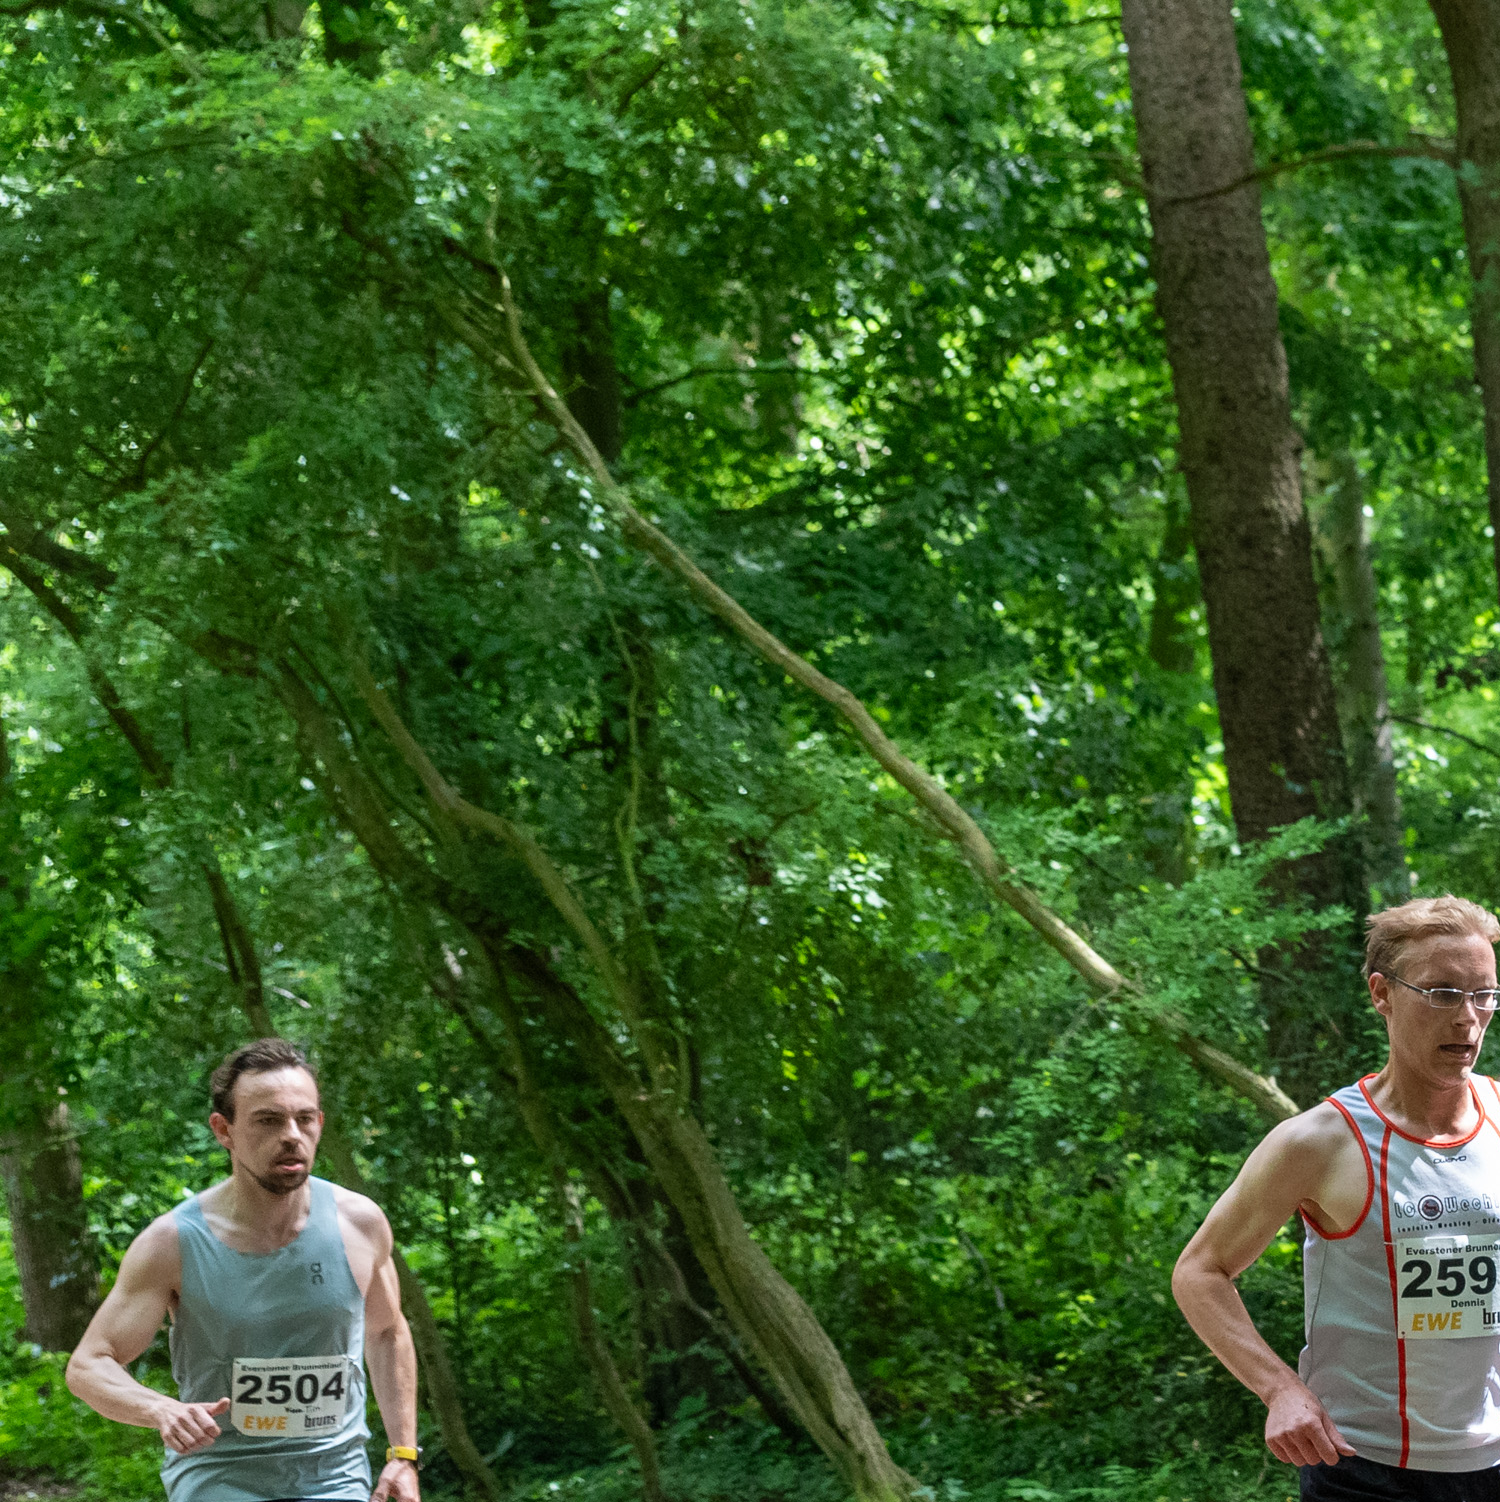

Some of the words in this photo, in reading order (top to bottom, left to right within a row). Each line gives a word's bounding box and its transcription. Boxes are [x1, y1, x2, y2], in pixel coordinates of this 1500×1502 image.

[1406, 1247, 1462, 1256] Everstener
[1451, 1298, 1485, 1308] Dennis
[1412, 1311, 1463, 1331] EWE
[236, 1371, 344, 1404] 2504
[243, 1415, 288, 1430] EWE
[304, 1414, 336, 1428] bruns
